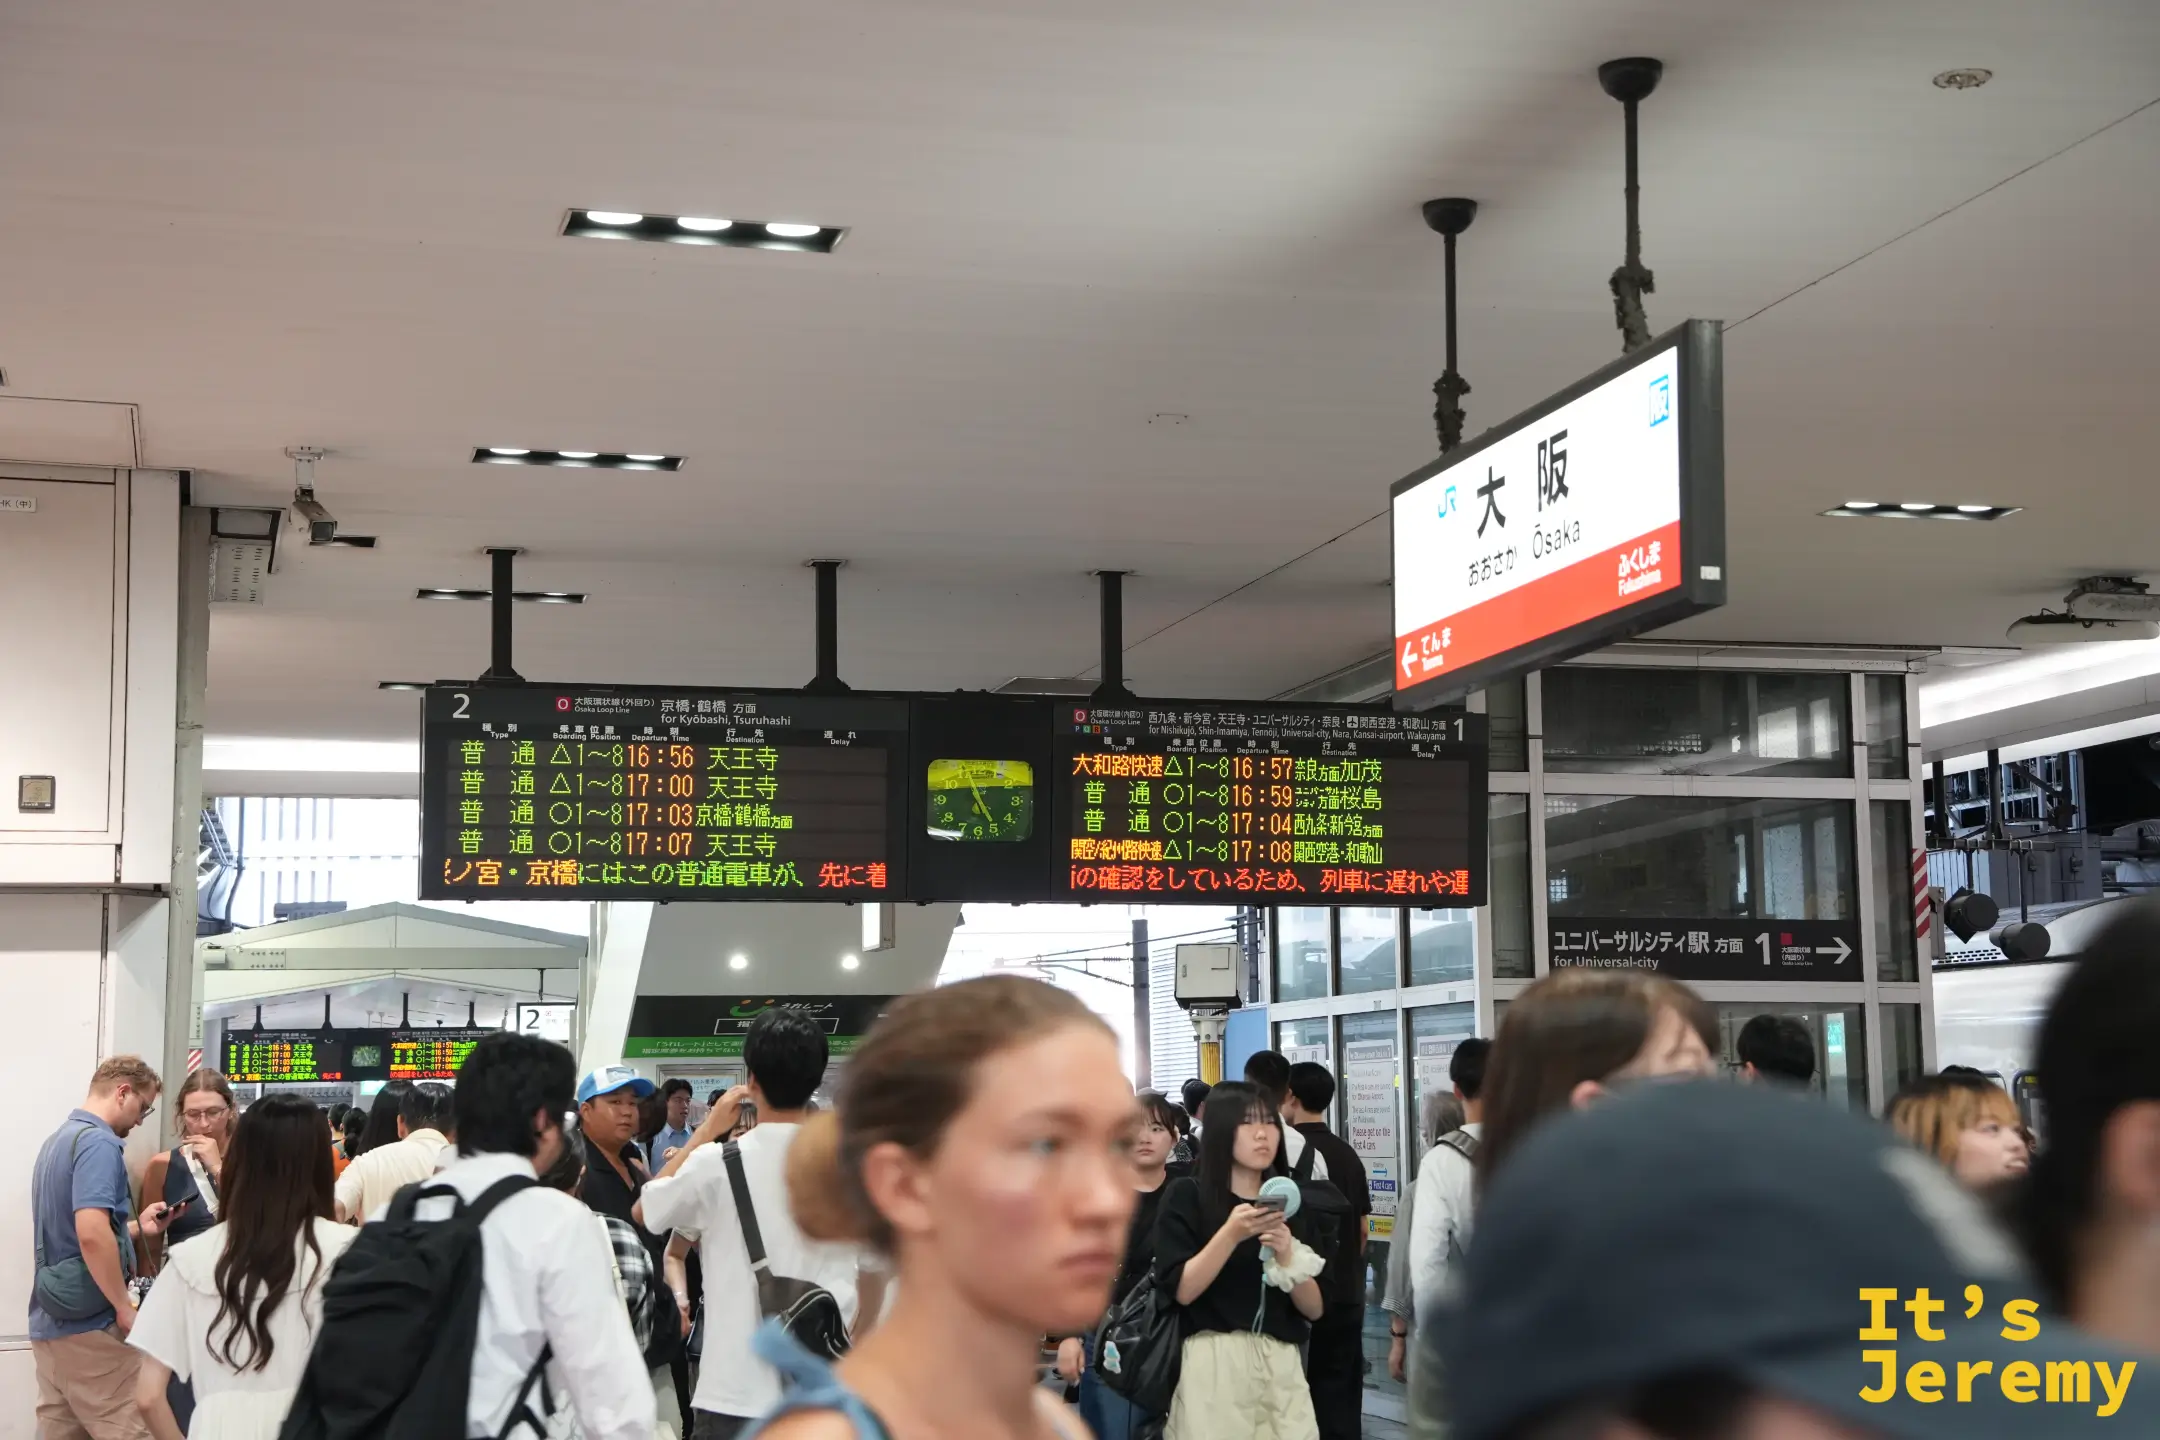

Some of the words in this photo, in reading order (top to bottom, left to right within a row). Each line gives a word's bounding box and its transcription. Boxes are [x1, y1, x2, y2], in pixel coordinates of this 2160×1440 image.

[1477, 429, 1569, 540] 大阪
[1438, 485, 1457, 518] JR
[1533, 520, 1580, 559] Ōsaka
[1469, 546, 1517, 586] おおさか
[1618, 540, 1661, 577] ふくしま
[1421, 626, 1452, 655] てんま
[452, 693, 470, 719] 2
[661, 714, 677, 724] for
[734, 715, 791, 726] Tsuruhashi
[1453, 718, 1464, 741] 1
[590, 733, 621, 741] Position
[632, 734, 667, 742] Departure
[725, 736, 765, 744] Destination
[830, 738, 850, 746] Delay
[1148, 725, 1160, 734] for
[1198, 726, 1250, 738] Shin-Imamiya,
[1281, 729, 1331, 739] Universal-city,
[1332, 730, 1352, 739] Nara,
[1353, 730, 1406, 741] Kansai-airport,
[1407, 731, 1446, 741] Wakayama
[628, 744, 694, 768] 16:56
[706, 746, 779, 771] 天王寺
[1237, 747, 1269, 755] Departure
[1417, 751, 1436, 759] Delay
[1072, 753, 1163, 777] 大和路快速
[1232, 757, 1293, 780] 16:57
[627, 773, 693, 797] 17:00
[706, 775, 779, 799] 天王寺
[1232, 784, 1292, 808] 16:59
[626, 802, 693, 827] 17:03
[1232, 812, 1292, 836] 17:04
[626, 832, 692, 856] 17:07
[705, 832, 778, 857] 天王寺
[1232, 840, 1292, 863] 17:08
[1754, 932, 1771, 965] 1
[1554, 956, 1573, 967] for
[1576, 956, 1659, 971] Universal-city
[526, 1009, 540, 1030] 2
[228, 1033, 234, 1041] 2
